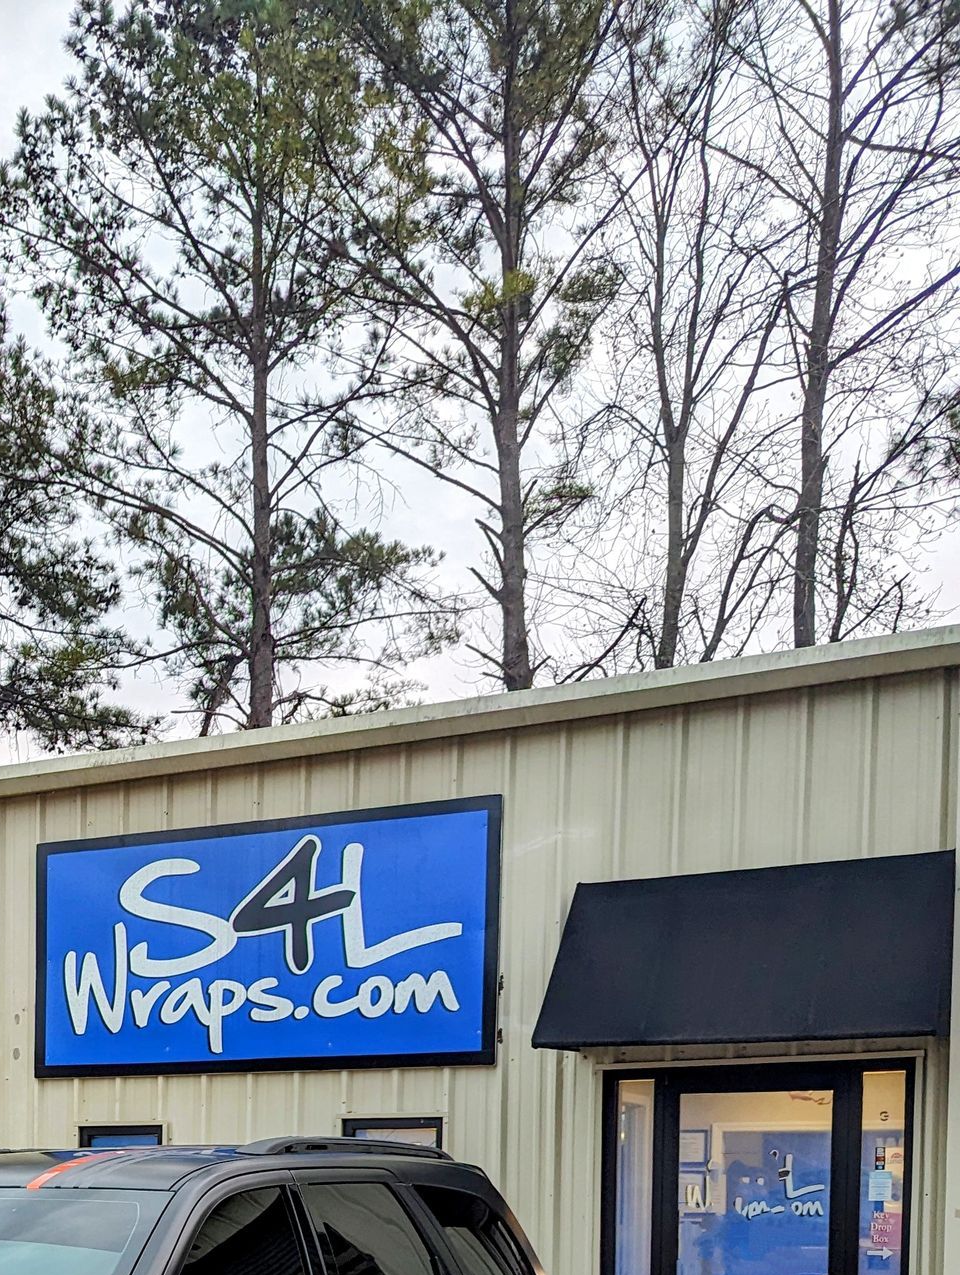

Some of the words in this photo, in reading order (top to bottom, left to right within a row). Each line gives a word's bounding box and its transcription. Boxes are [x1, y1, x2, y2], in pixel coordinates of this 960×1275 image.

[118, 834, 463, 978] S4L
[63, 921, 461, 1054] Wraps.com
[873, 1211, 889, 1221] Key
[871, 1222, 892, 1233] Drop
[873, 1234, 889, 1243] Box
